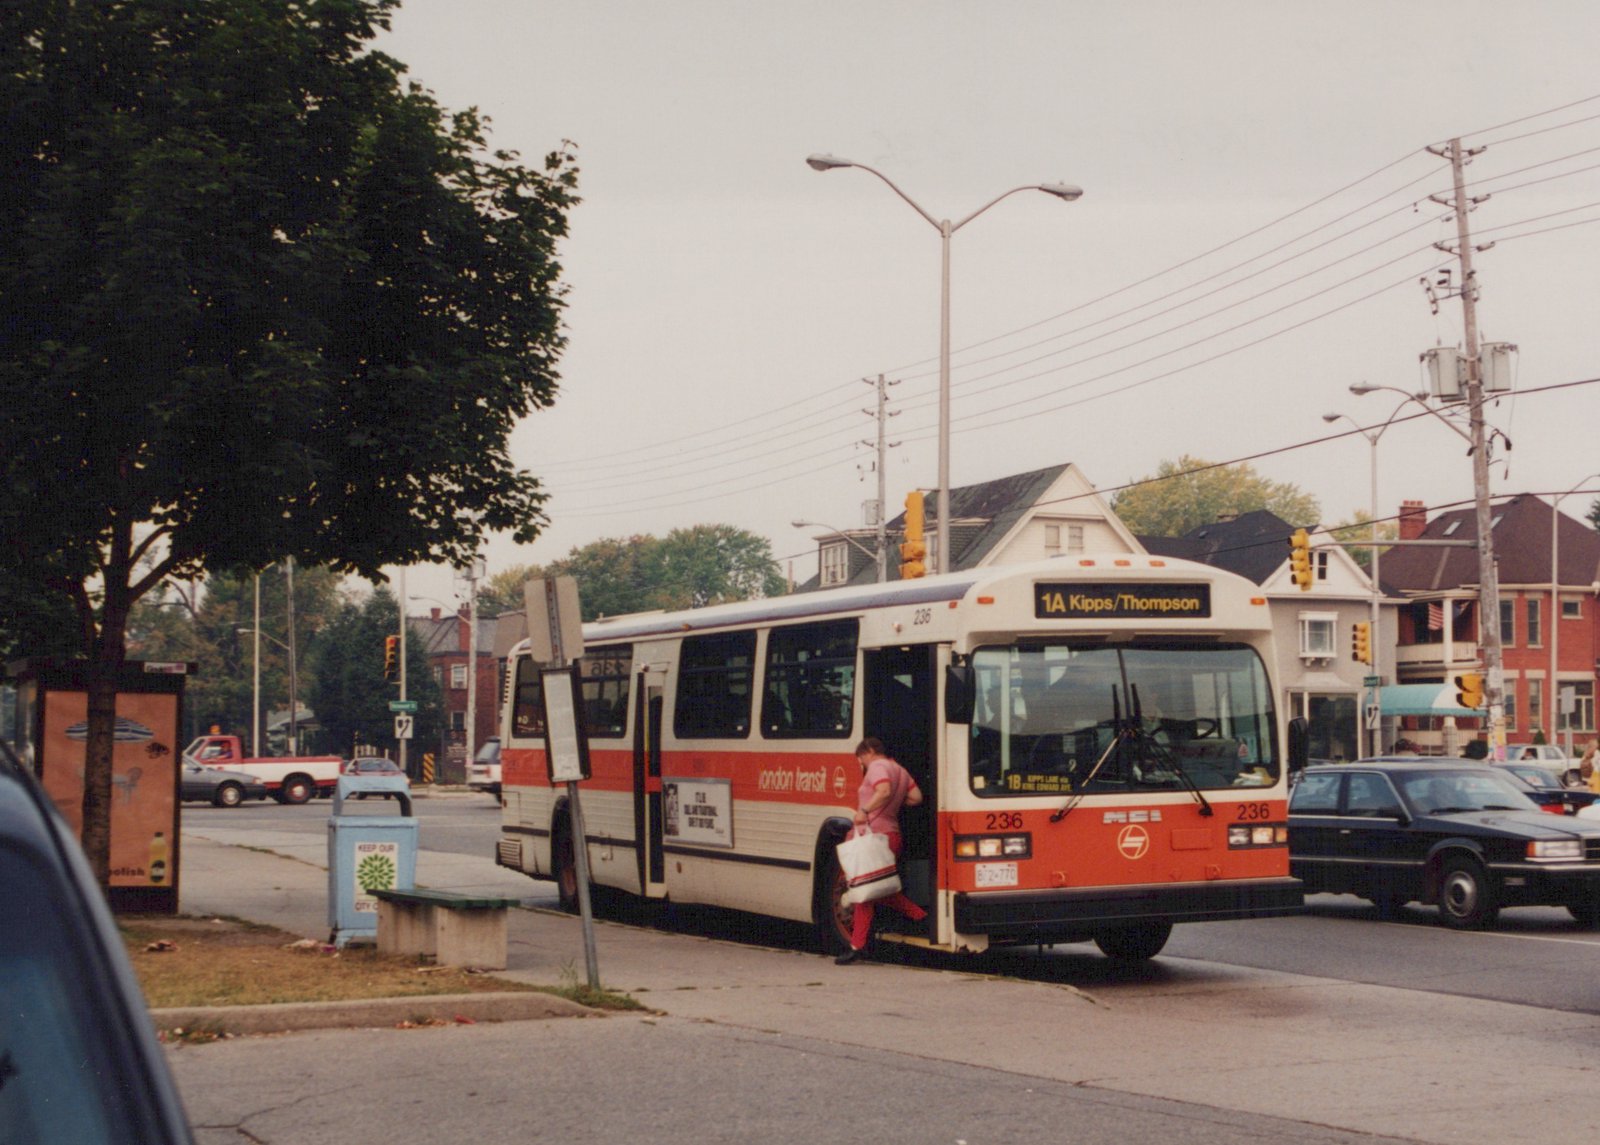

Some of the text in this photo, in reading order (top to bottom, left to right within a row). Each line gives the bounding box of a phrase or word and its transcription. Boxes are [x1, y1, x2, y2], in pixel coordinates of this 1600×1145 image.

[1041, 592, 1200, 613] 1A Kipps/Thompson
[913, 608, 932, 625] 236
[758, 766, 827, 792] london transit
[1007, 773, 1021, 790] 1B
[1237, 802, 1270, 821] 236
[986, 812, 1024, 830] 236
[358, 844, 395, 853] KEEP OUR
